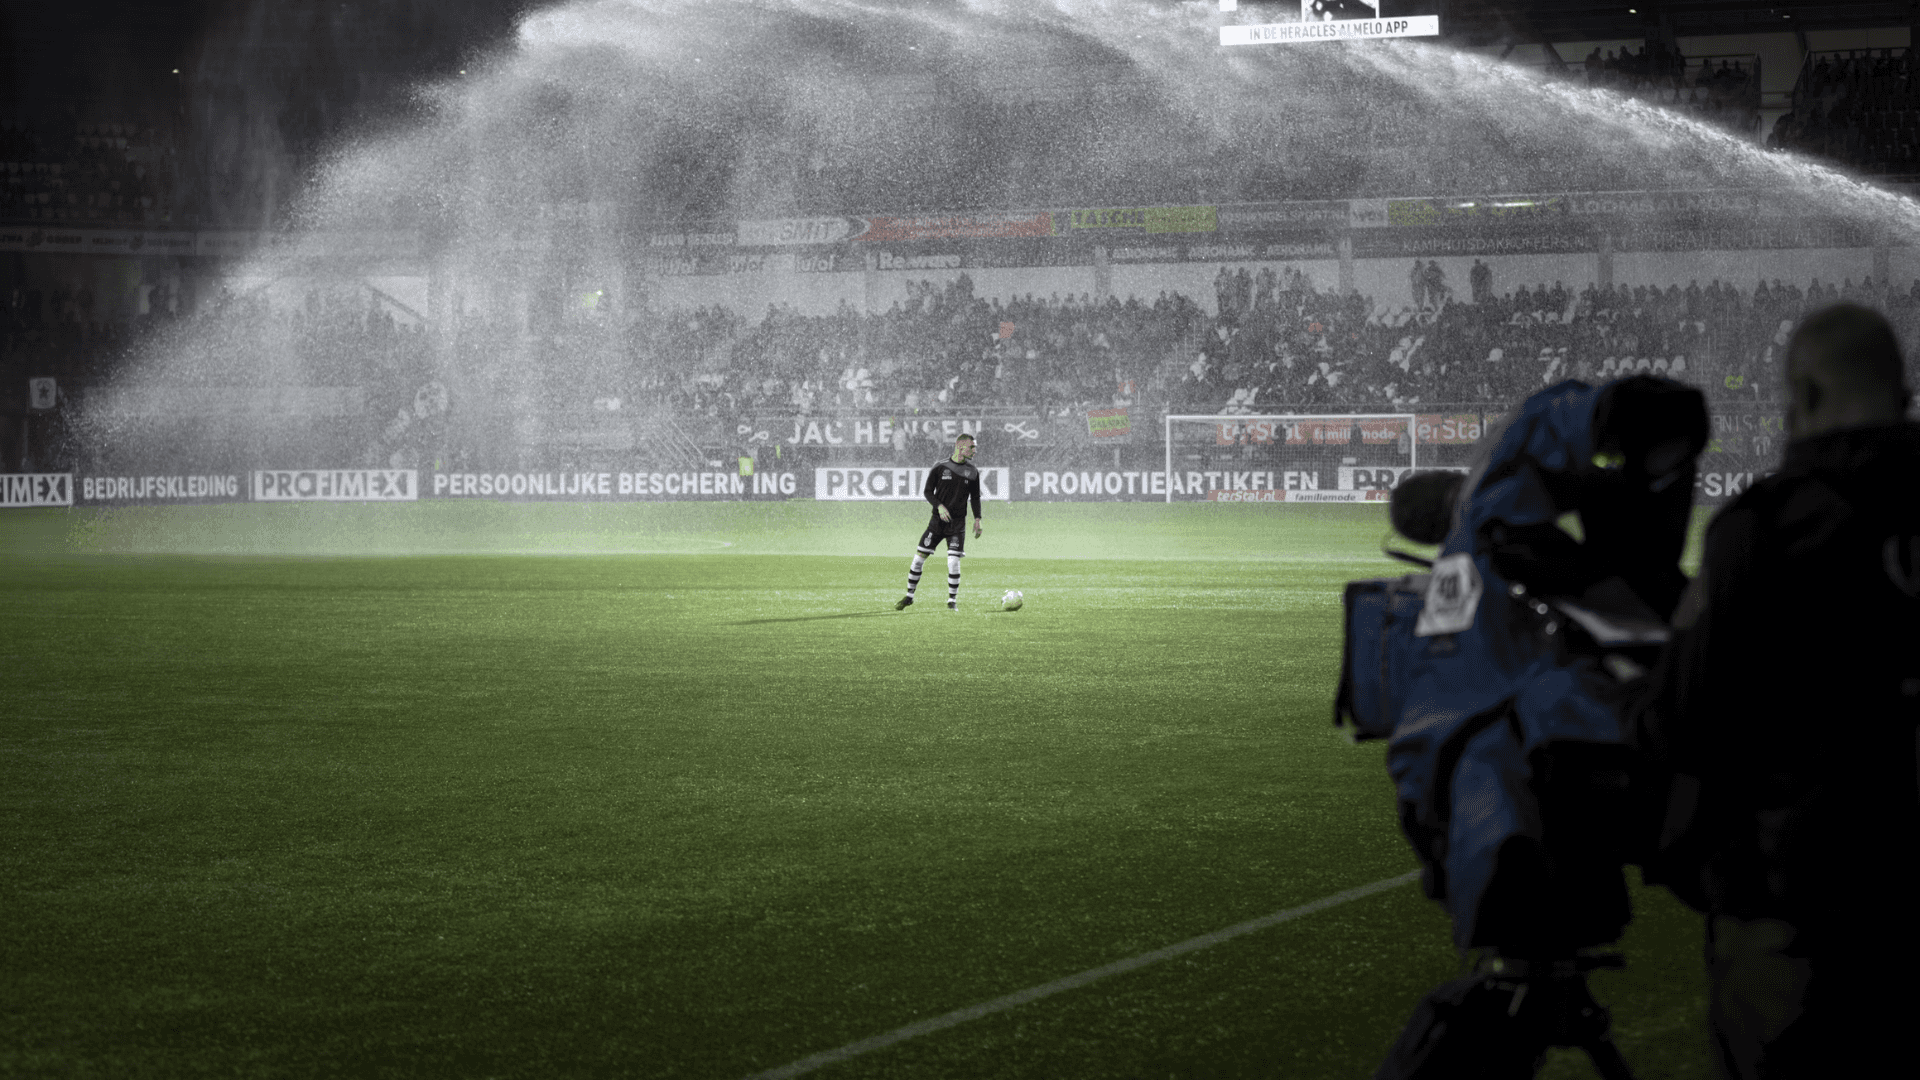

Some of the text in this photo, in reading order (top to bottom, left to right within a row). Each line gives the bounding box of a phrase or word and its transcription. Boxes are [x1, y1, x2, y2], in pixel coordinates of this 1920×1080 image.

[1250, 28, 1260, 41] IN
[1264, 27, 1278, 40] DE
[1280, 24, 1336, 40] HERACLES
[1385, 20, 1409, 34] APP
[788, 420, 843, 445] JAC
[83, 476, 238, 501] BEDRIJFSKLEDING
[261, 471, 410, 498] PROFIMEX
[434, 472, 797, 496] PERSOONLIJKE BESCHERMING
[1295, 491, 1357, 503] familiemode
